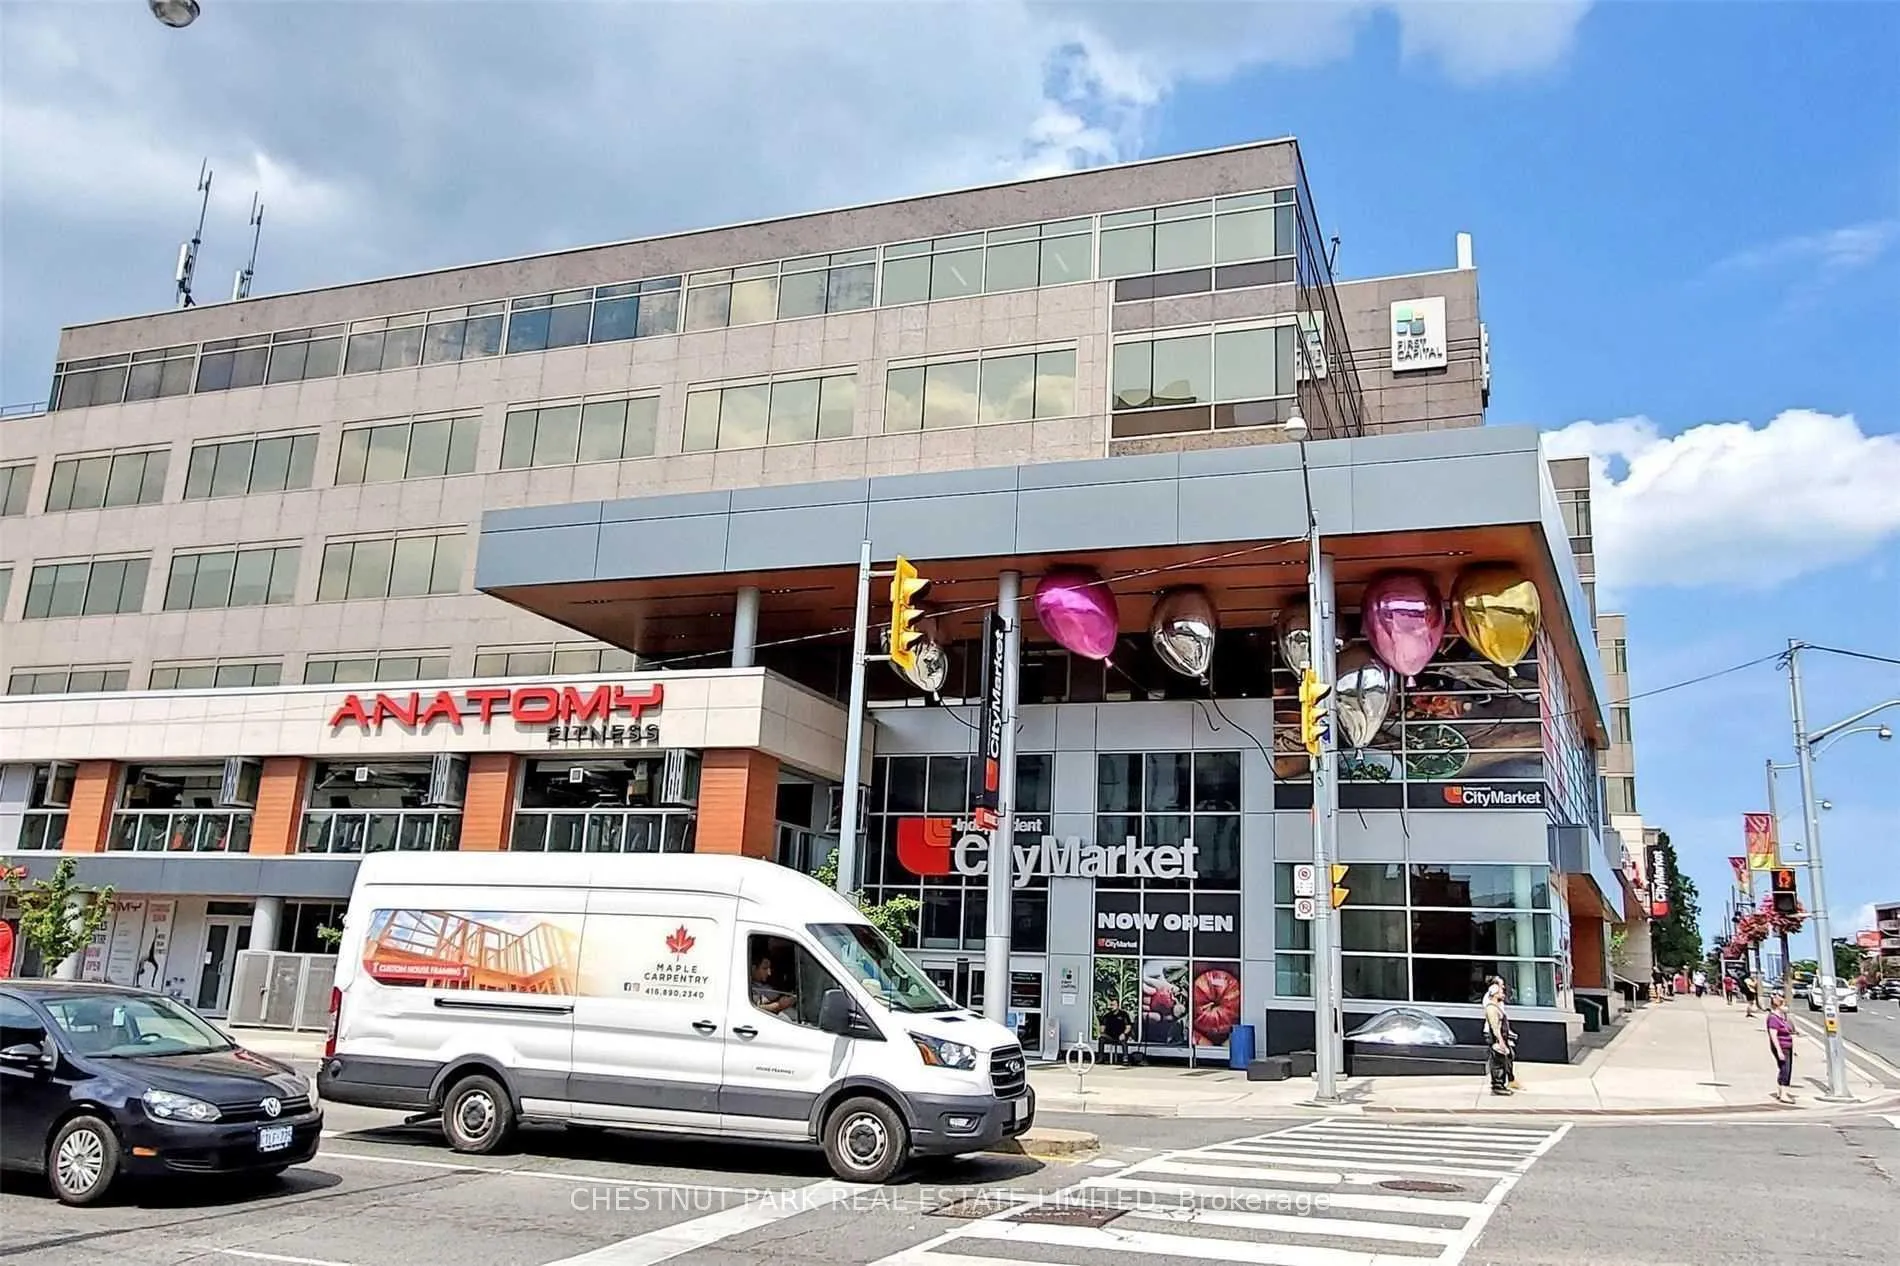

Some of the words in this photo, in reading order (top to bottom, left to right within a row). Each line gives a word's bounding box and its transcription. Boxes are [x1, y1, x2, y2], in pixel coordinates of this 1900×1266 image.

[1396, 338, 1427, 351] FIRST
[1396, 347, 1443, 361] CAPITAL
[990, 629, 1005, 758] CityMarket
[328, 683, 664, 727] ANATOMY
[547, 725, 660, 743] FITNESS
[1462, 791, 1542, 807] CityMarket
[954, 834, 1199, 888] CyMarket
[1097, 912, 1160, 930] NOW
[1163, 913, 1233, 932] OPEN
[656, 963, 698, 974] MAPLE
[643, 972, 709, 984] CARPENTRY
